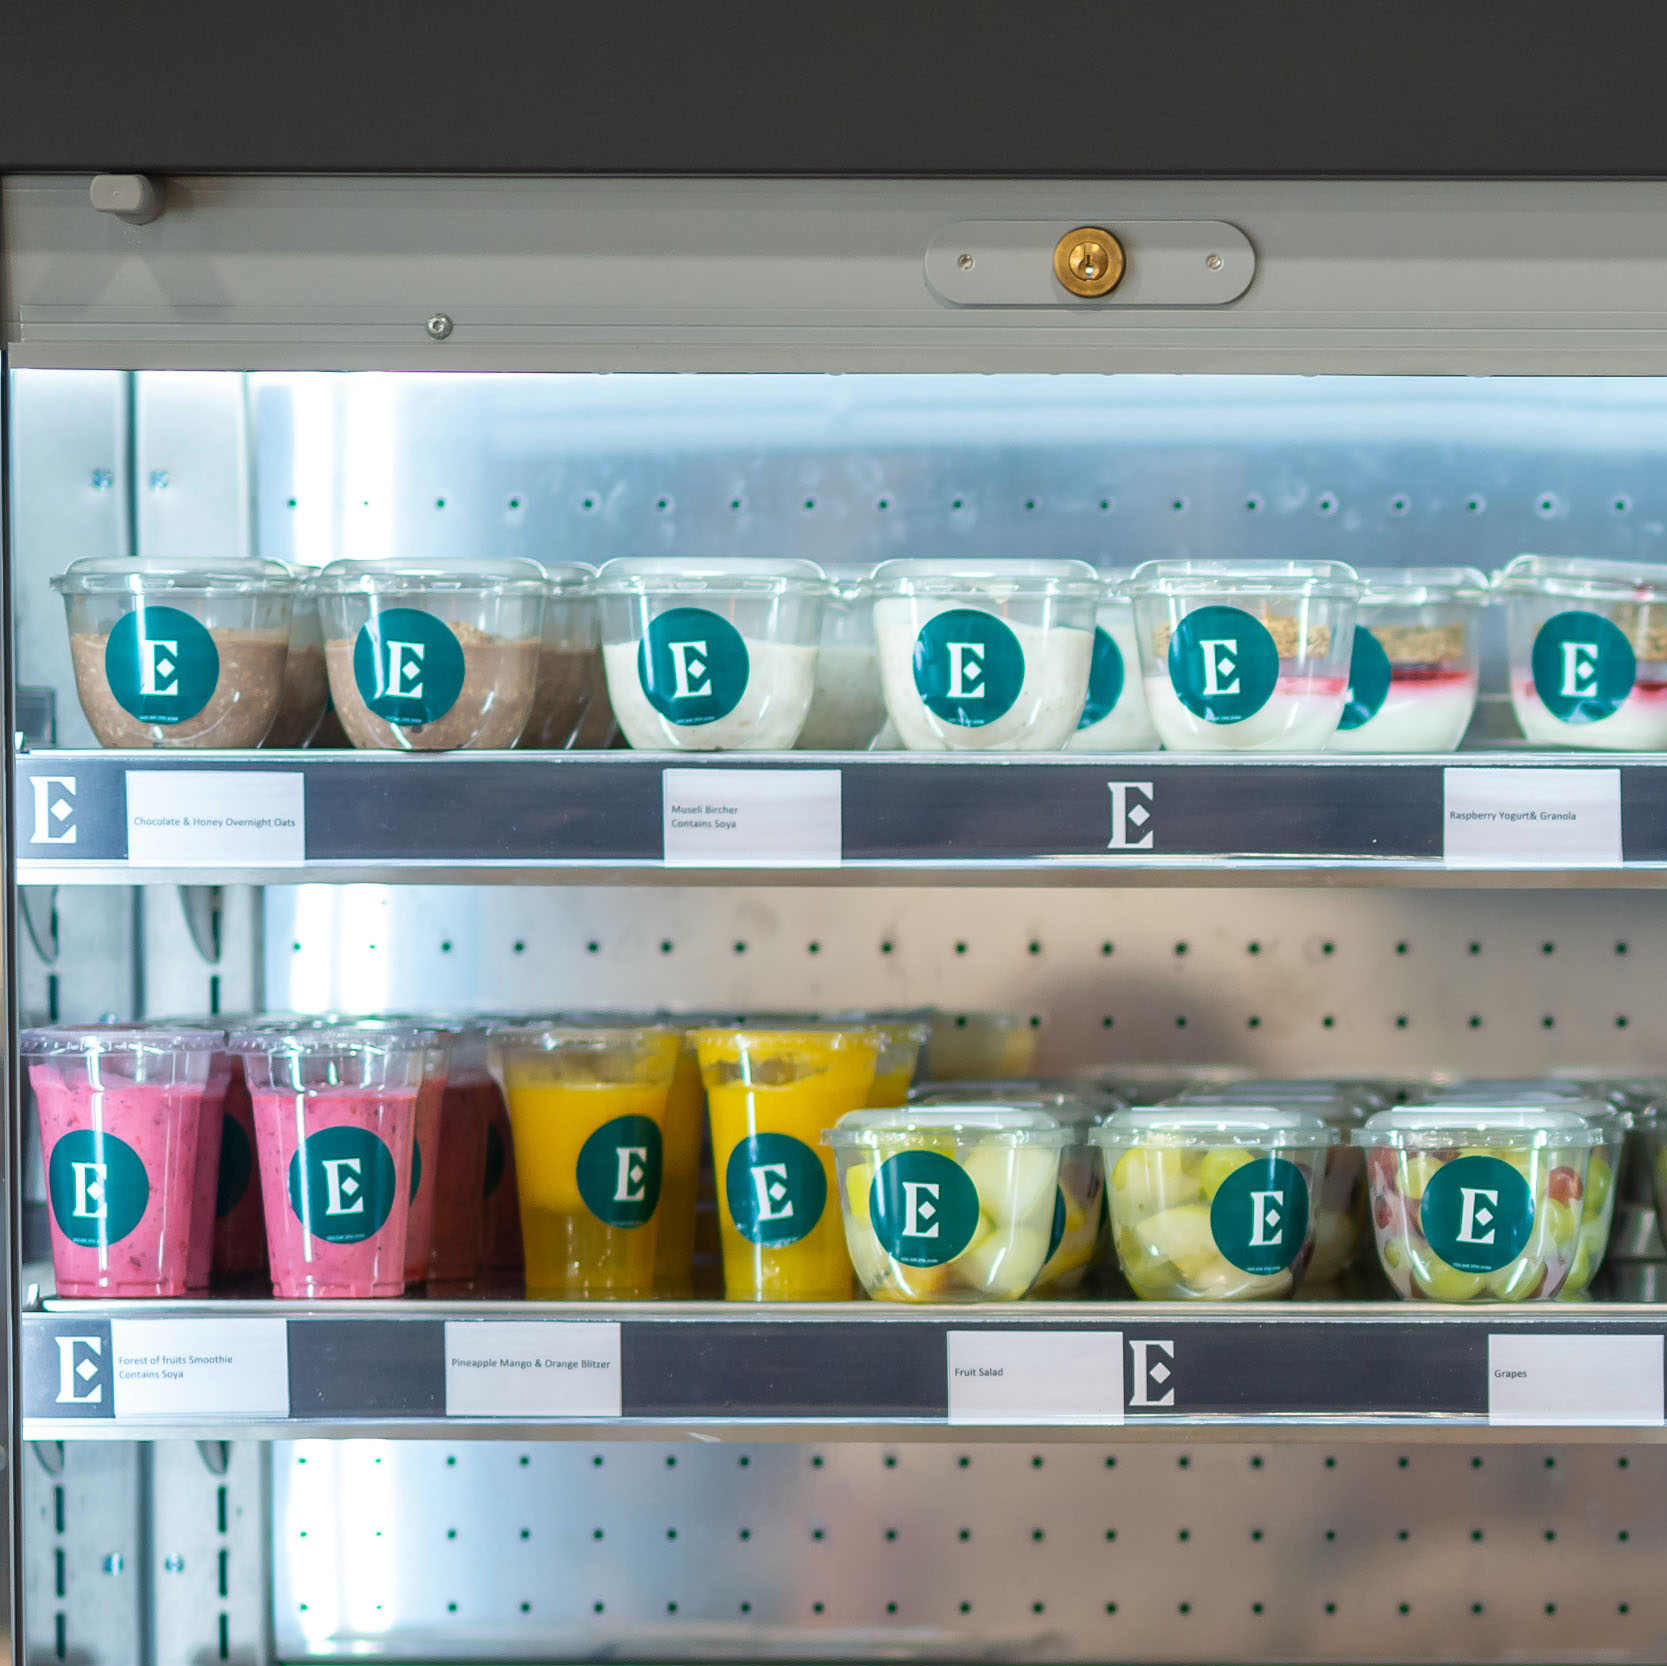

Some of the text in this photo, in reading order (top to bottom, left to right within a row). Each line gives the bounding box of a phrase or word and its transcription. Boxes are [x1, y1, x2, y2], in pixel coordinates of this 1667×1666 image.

[140, 641, 179, 695] E
[30, 776, 77, 843] E
[704, 805, 739, 815] Bircher
[1107, 782, 1153, 848] E
[133, 816, 297, 829] Chocolate & Honey Overnight Oats
[1449, 810, 1577, 823] Raspberry Yogurt& Granola
[671, 818, 737, 830] Contains Soya
[1456, 1188, 1498, 1244] E
[451, 1357, 611, 1371] Pineapple Mango & Orange Blitzer
[954, 1367, 1004, 1377] Fruit Salad
[1129, 1341, 1174, 1405] E
[1493, 1369, 1528, 1380] Grapes
